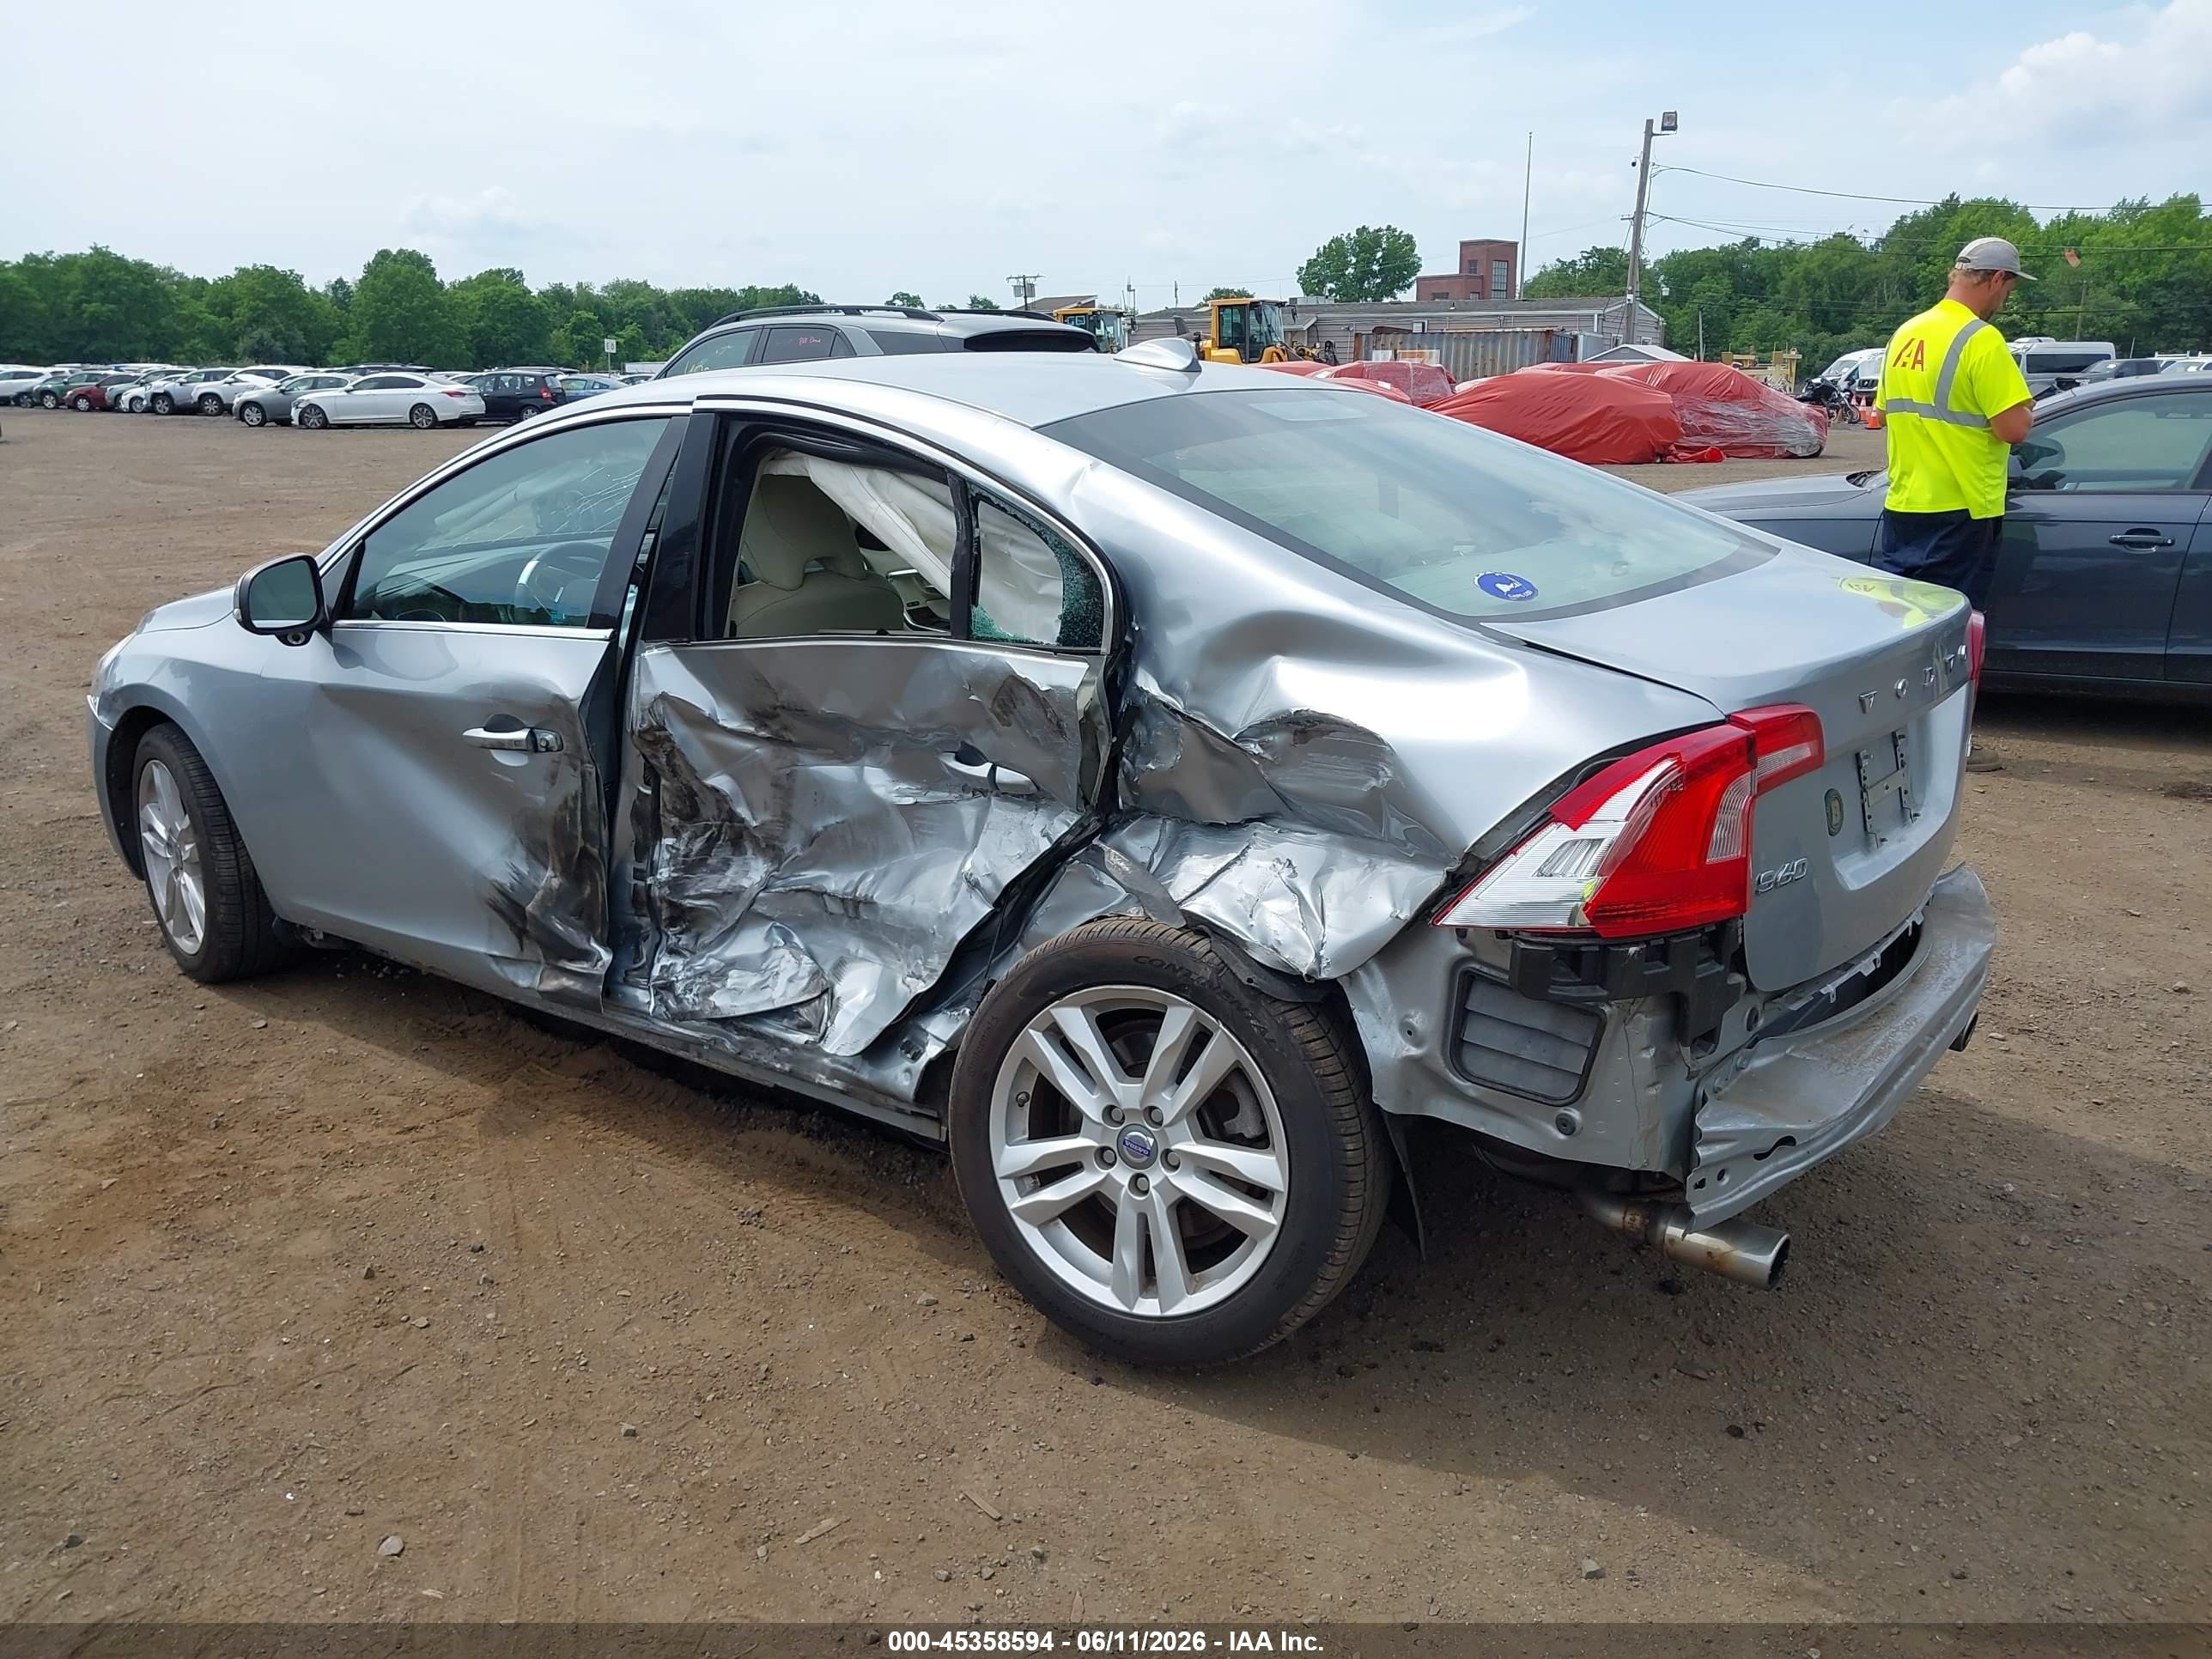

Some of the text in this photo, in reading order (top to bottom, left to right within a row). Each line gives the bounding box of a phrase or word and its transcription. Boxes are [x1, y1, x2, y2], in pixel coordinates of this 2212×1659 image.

[1858, 644, 1968, 714] VOLVO
[1755, 857, 1808, 895] S60
[1125, 1139, 1150, 1155] VOLVO
